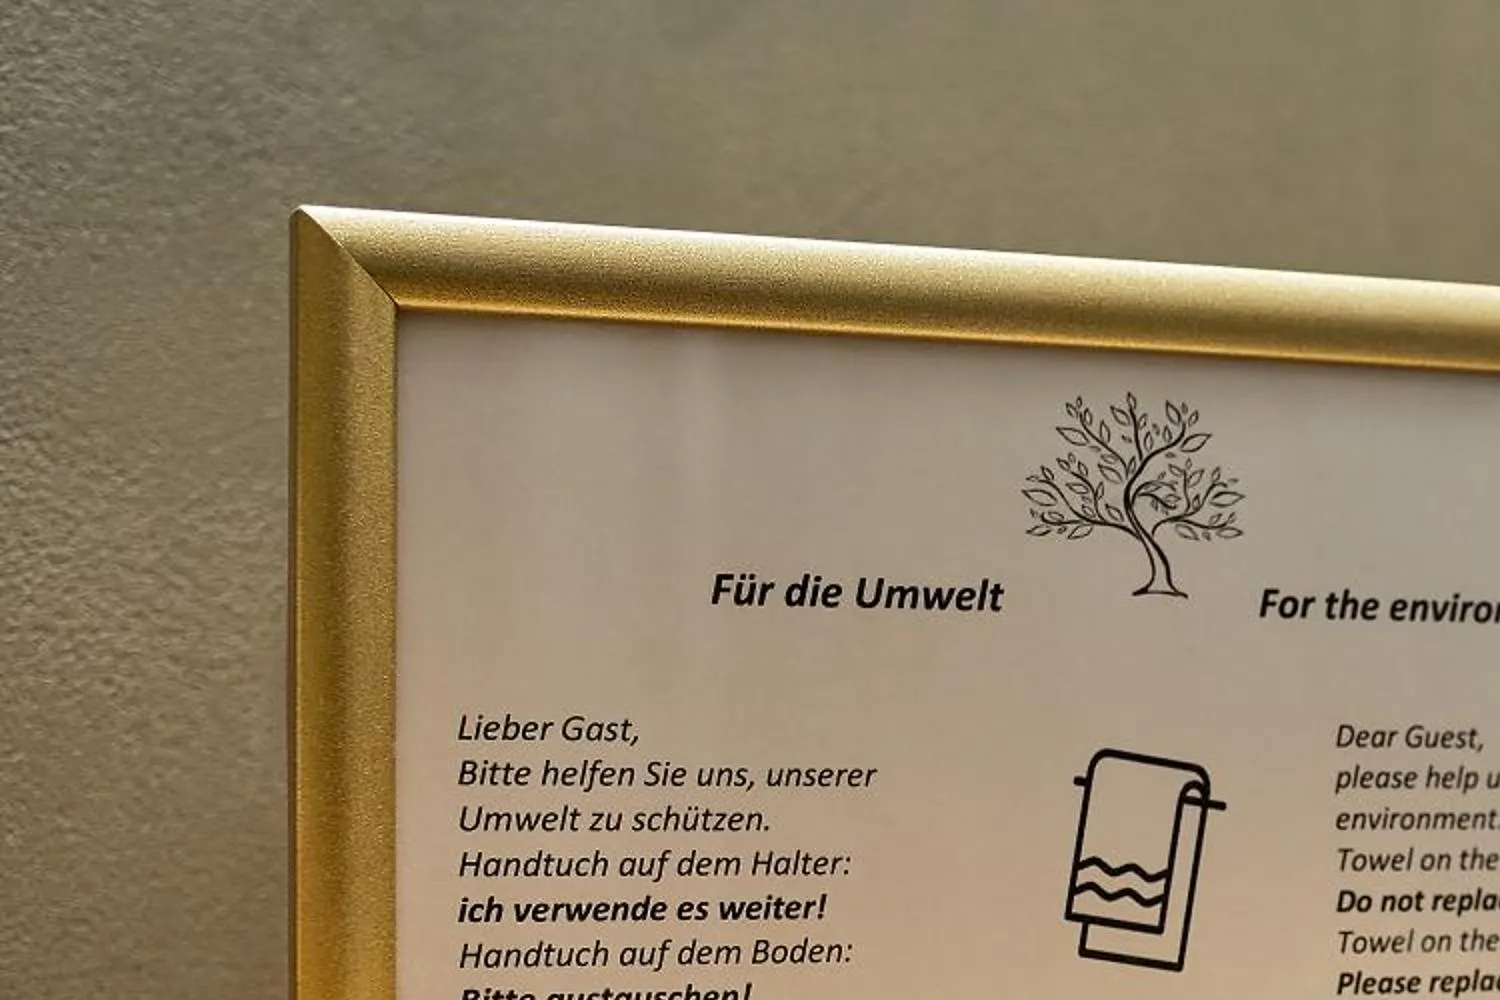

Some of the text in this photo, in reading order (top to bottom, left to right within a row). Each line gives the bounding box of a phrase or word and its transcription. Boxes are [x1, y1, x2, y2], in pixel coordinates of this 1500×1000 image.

[711, 572, 1005, 613] Für die Umwelt
[1258, 587, 1317, 620] For
[1324, 587, 1381, 622] the
[457, 713, 639, 747] Lieber Gast,
[1335, 723, 1484, 753] Dear Guest,
[457, 758, 879, 793] Bitte helfen Sie uns, unserer
[1334, 764, 1419, 795] please
[1425, 764, 1480, 795] help
[459, 804, 770, 833] Umwelt zu schützen.
[458, 849, 851, 883] Handtuch auf dem Halter:
[1337, 847, 1415, 873] Towel
[1419, 853, 1452, 872] on
[1459, 847, 1500, 872] the
[457, 893, 828, 924] ich verwende es weiter!
[1335, 889, 1373, 914] Do
[1380, 890, 1425, 913] not
[459, 936, 853, 973] Handtuch auf dem Boden:
[1338, 927, 1415, 955] Towel
[1420, 934, 1452, 953] on
[1460, 927, 1500, 953] the
[1336, 969, 1422, 996] Please
